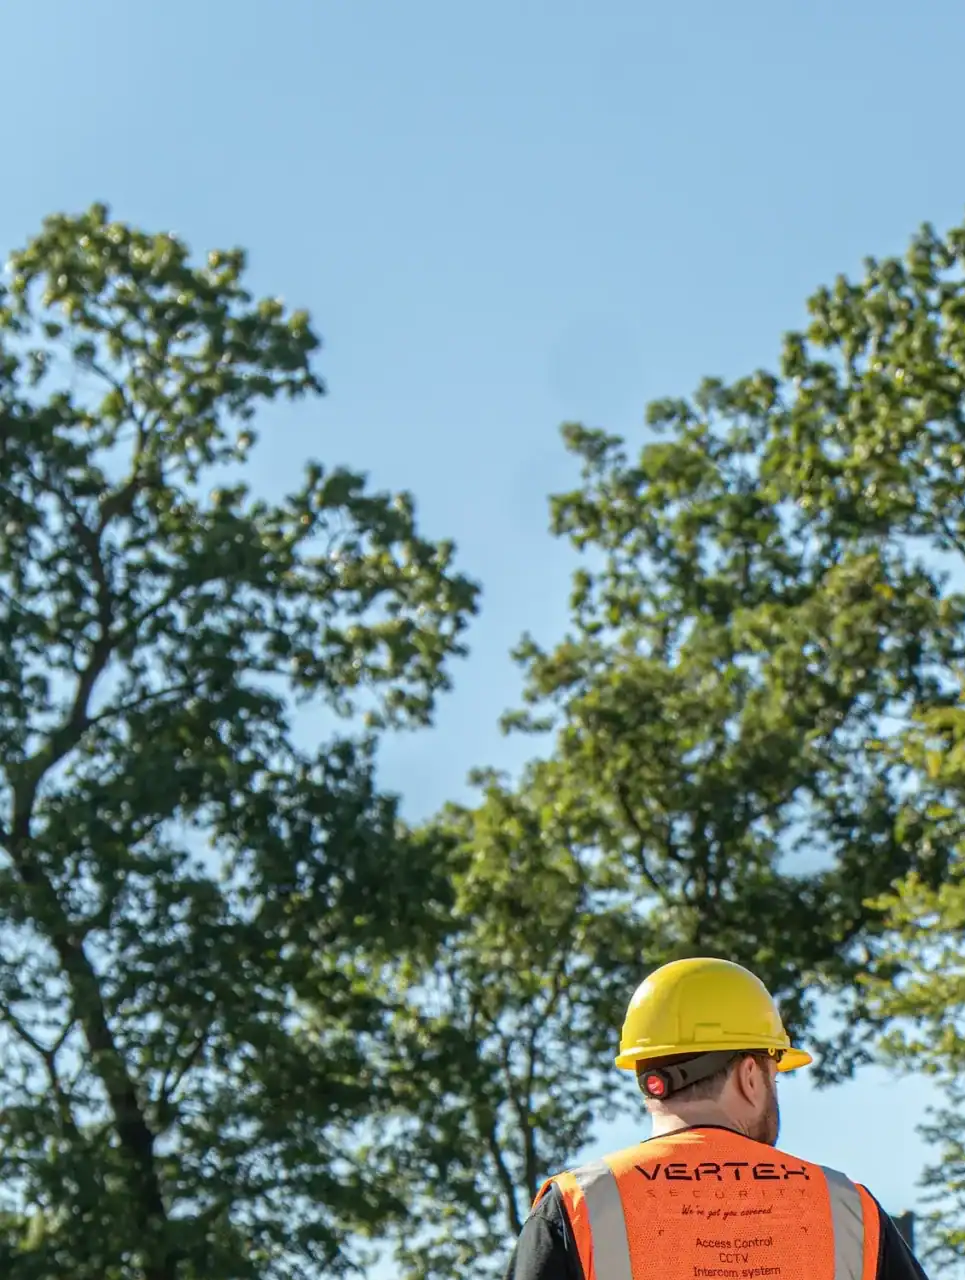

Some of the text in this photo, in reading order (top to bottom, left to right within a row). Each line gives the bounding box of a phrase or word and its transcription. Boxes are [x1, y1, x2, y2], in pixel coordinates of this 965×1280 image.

[634, 1162, 810, 1181] VERTEX
[645, 1188, 806, 1199] SECURITY
[681, 1204, 773, 1220] We've got you covered
[695, 1236, 773, 1248] Access Control
[719, 1253, 749, 1263] CCTV
[693, 1266, 781, 1279] Intercom system
